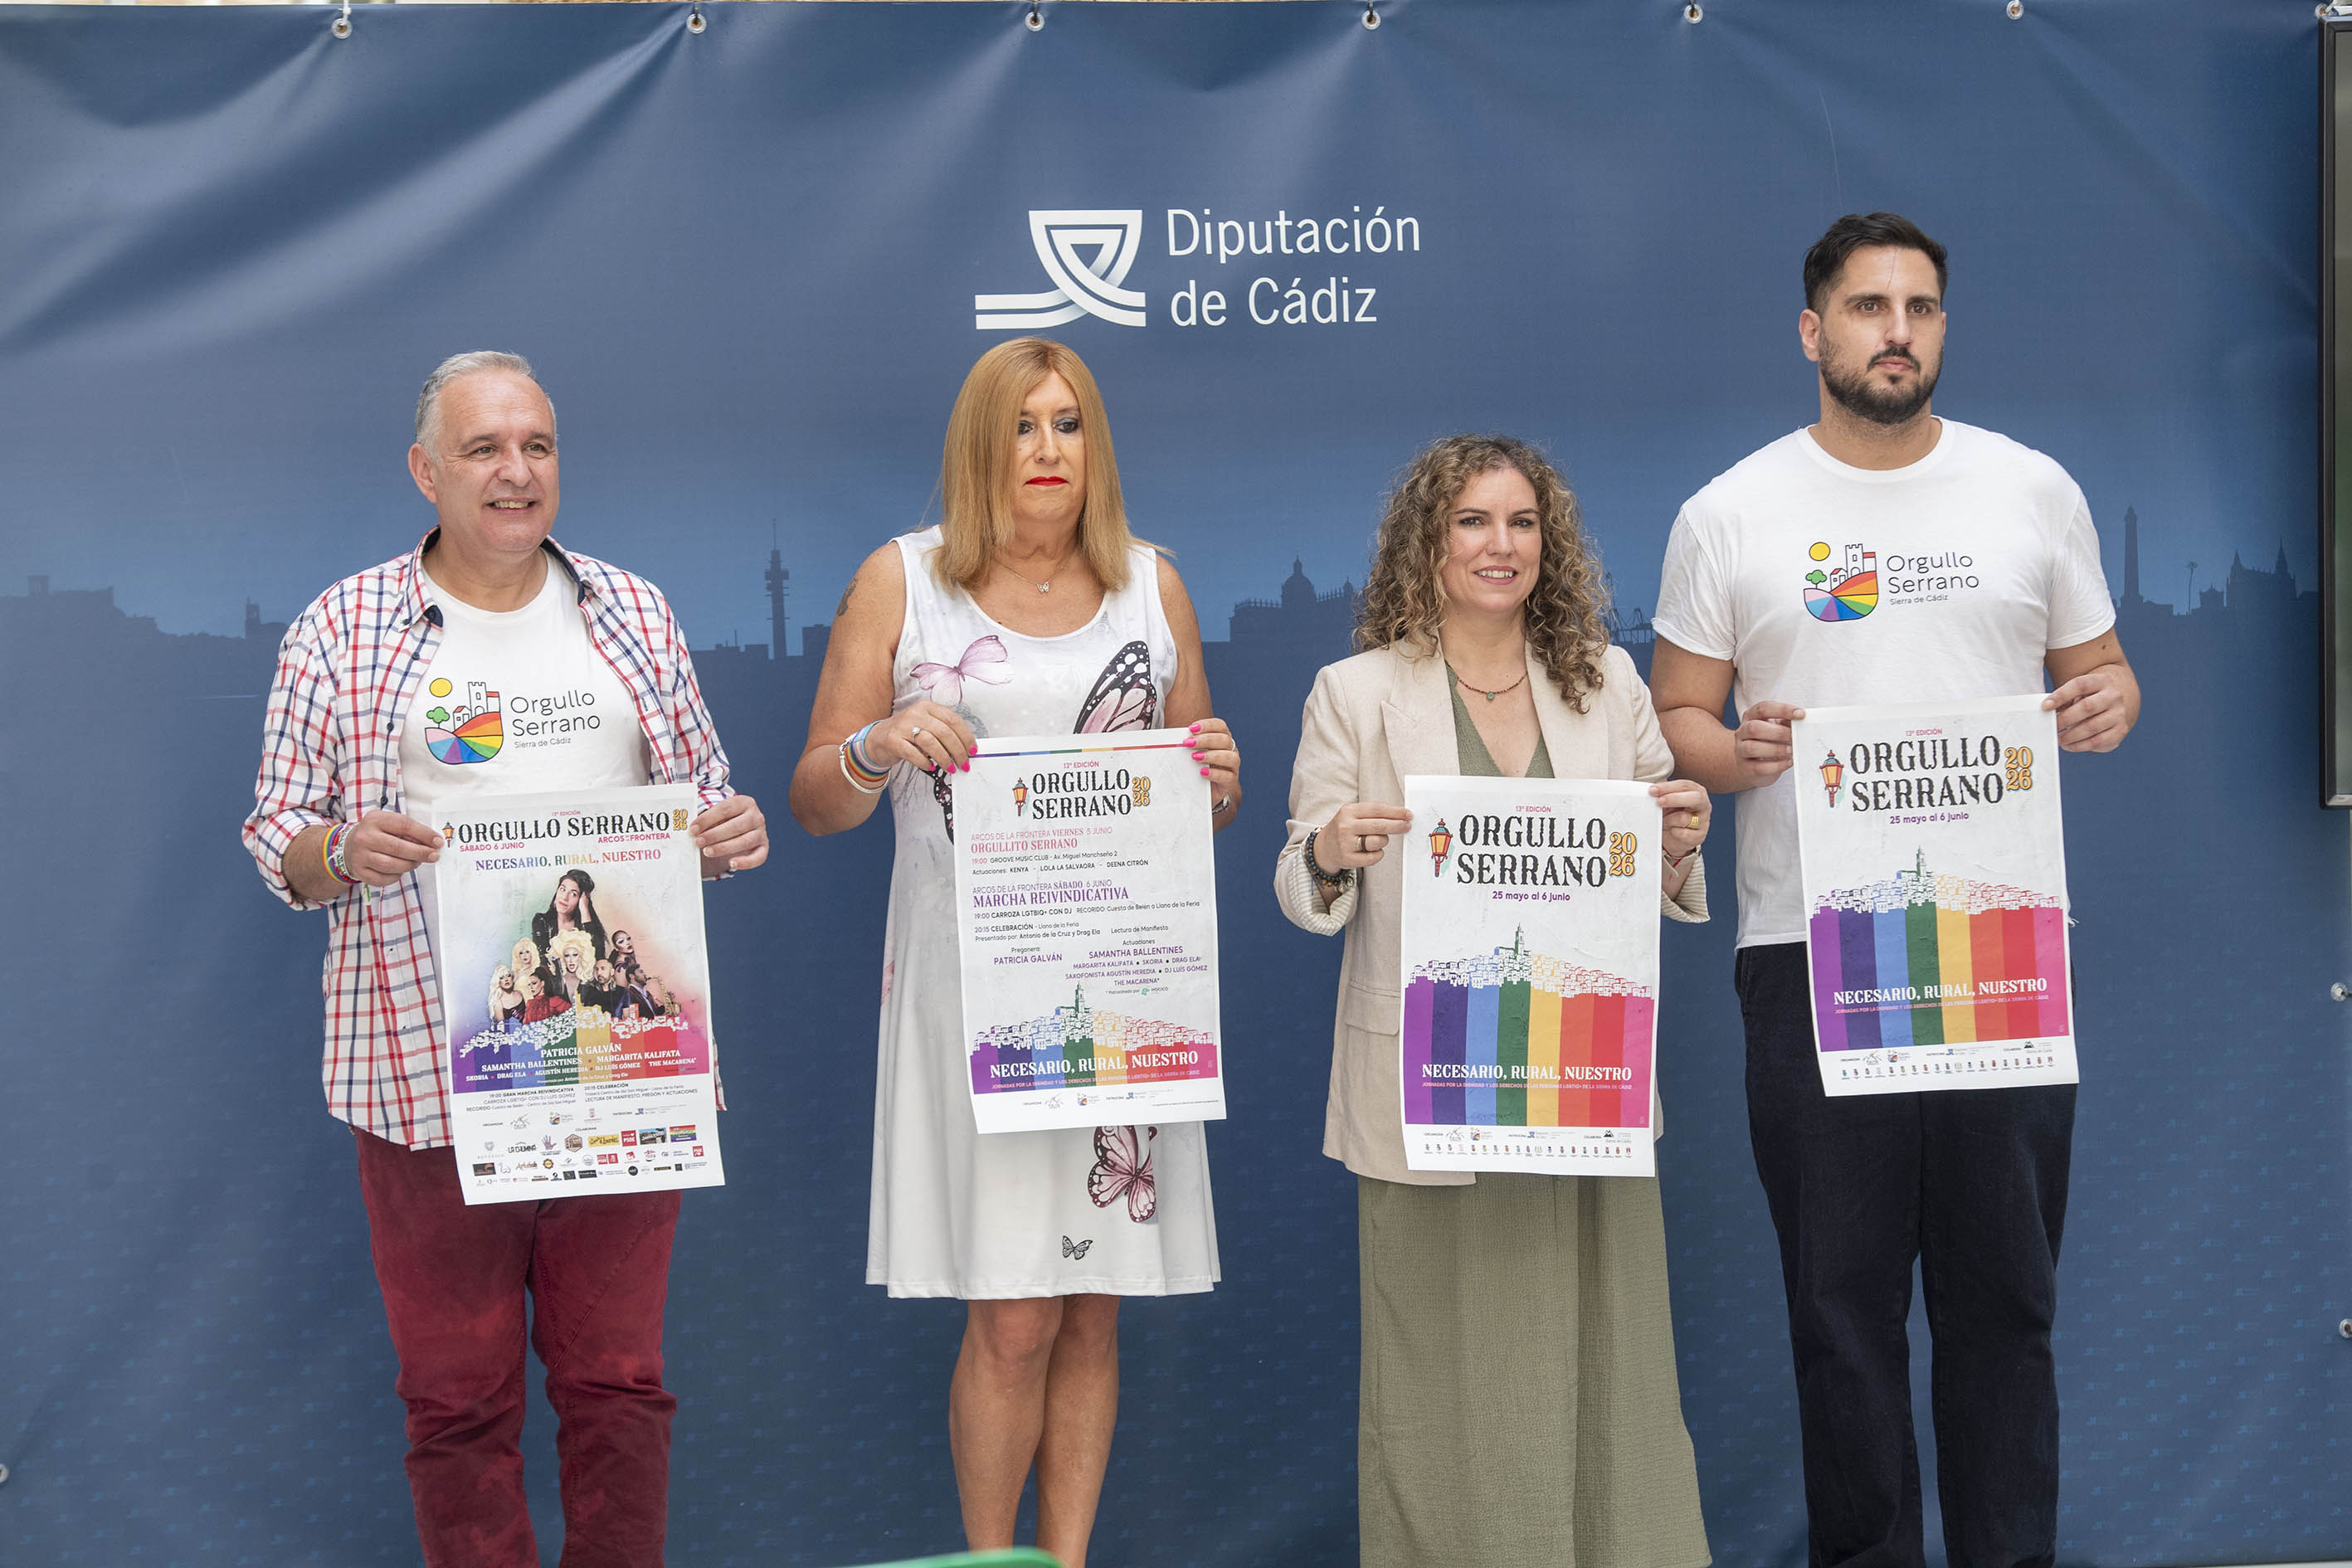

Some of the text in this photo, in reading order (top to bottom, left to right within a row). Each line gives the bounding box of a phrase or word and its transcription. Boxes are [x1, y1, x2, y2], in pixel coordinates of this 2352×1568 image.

[1167, 205, 1420, 264] Diputación
[1171, 276, 1378, 327] de Cádiz
[1887, 552, 1973, 573] Orgullo
[1888, 575, 1979, 594] Serrano
[1890, 594, 1948, 606] Sierra de Cádiz
[510, 689, 595, 716] Orgullo
[512, 715, 601, 737] Serrano
[514, 740, 537, 748] Sierra
[549, 737, 572, 745] Cádiz
[1850, 735, 2000, 775] ORGULLO
[2004, 746, 2033, 769] 20
[1032, 768, 1130, 794] ORGULLO
[1132, 776, 1151, 791] 20
[2005, 768, 2032, 791] 26
[1132, 791, 1150, 806] 26
[1852, 772, 2004, 811] SERRANO
[673, 809, 689, 820] 20
[1032, 794, 1132, 820] SERRANO
[673, 819, 688, 830] 26
[1890, 811, 1970, 824] 25 mayo al 6 junio
[458, 812, 670, 844] ORGULLO SERRANO
[971, 833, 995, 841] ARCOS
[1006, 831, 1015, 840] LA
[1015, 830, 1050, 839] FRONTERA
[1052, 828, 1083, 837] VIERNES
[1093, 826, 1113, 835] JUNIO
[1459, 815, 1606, 850] ORGULLO
[630, 833, 670, 841] FRONTERA
[1609, 831, 1637, 855] 20
[460, 843, 492, 852] SÁBADO
[500, 841, 525, 850] JUNIO
[971, 838, 1078, 854] ORGULLITO SERRANO
[475, 849, 661, 870] NECESARIO, RURAL, NUESTRO
[1063, 852, 1081, 860] Miguel
[1126, 858, 1149, 866] CITRÓN
[1457, 853, 1606, 888] SERRANO
[1609, 854, 1635, 876] 26
[972, 886, 996, 894] ARCOS
[1017, 883, 1052, 891] FRONTERA
[1054, 880, 1083, 889] SÁBADO
[1092, 879, 1113, 887] JUNIO
[973, 886, 1129, 908] MARCHA REIVINDICATIVA
[1493, 890, 1570, 903] 25 mayo al 6 junio
[990, 923, 1034, 933] CELEBRACIÓN
[1141, 924, 1169, 933] Manifiesto
[994, 952, 1062, 965] PATRICIA GALVÁN
[1088, 945, 1183, 959] SAMANTHA BALLENTINES
[1065, 971, 1105, 980] SAXOFONISTA
[1106, 968, 1131, 976] AGUSTÍN
[1833, 986, 1921, 1006] NECESARIO,
[1924, 983, 1975, 999] RURAL,
[1978, 977, 2048, 996] NUESTRO
[541, 1042, 622, 1058] PATRICIA GALVÁN
[481, 1049, 681, 1072] SAMANTHA BALLENTINES MARGARITA KALIFATA
[990, 1059, 1075, 1079] NECESARIO,
[1079, 1056, 1128, 1072] RURAL,
[1132, 1050, 1198, 1069] NUESTRO
[534, 1067, 562, 1076] AGUSTÍN
[1422, 1064, 1633, 1081] NECESARIO, RURAL, NUESTRO
